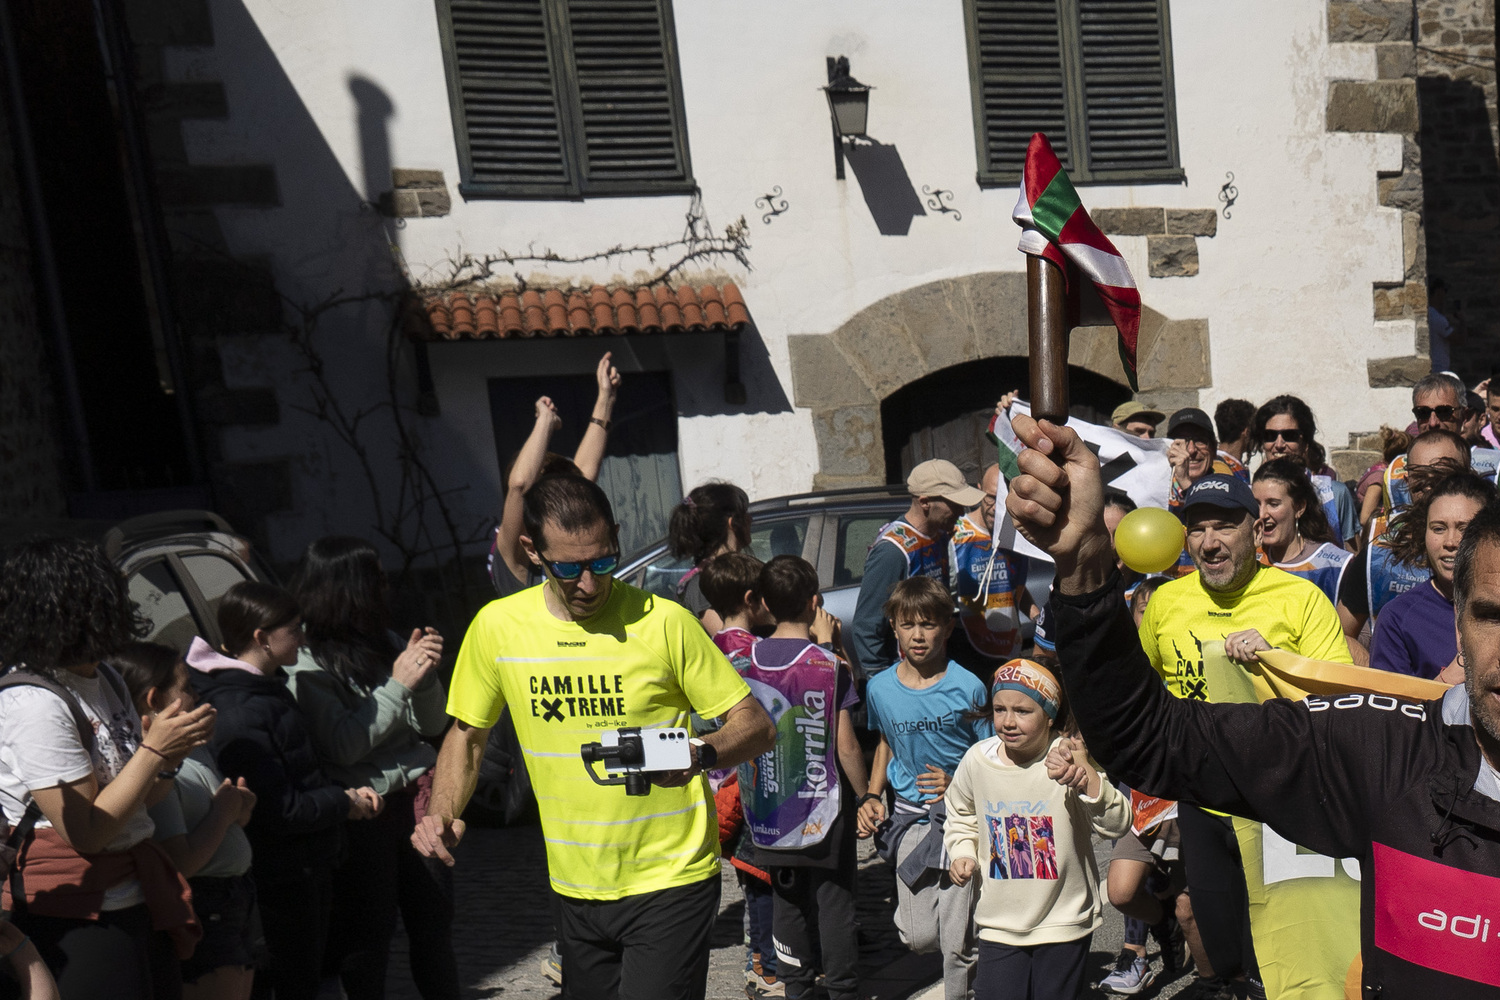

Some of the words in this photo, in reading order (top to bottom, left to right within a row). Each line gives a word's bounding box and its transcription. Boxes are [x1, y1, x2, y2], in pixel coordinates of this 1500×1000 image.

[1190, 480, 1230, 495] HOKA
[529, 674, 624, 695] CAMILLE
[530, 697, 627, 723] EXTREME
[795, 689, 828, 800] korrika
